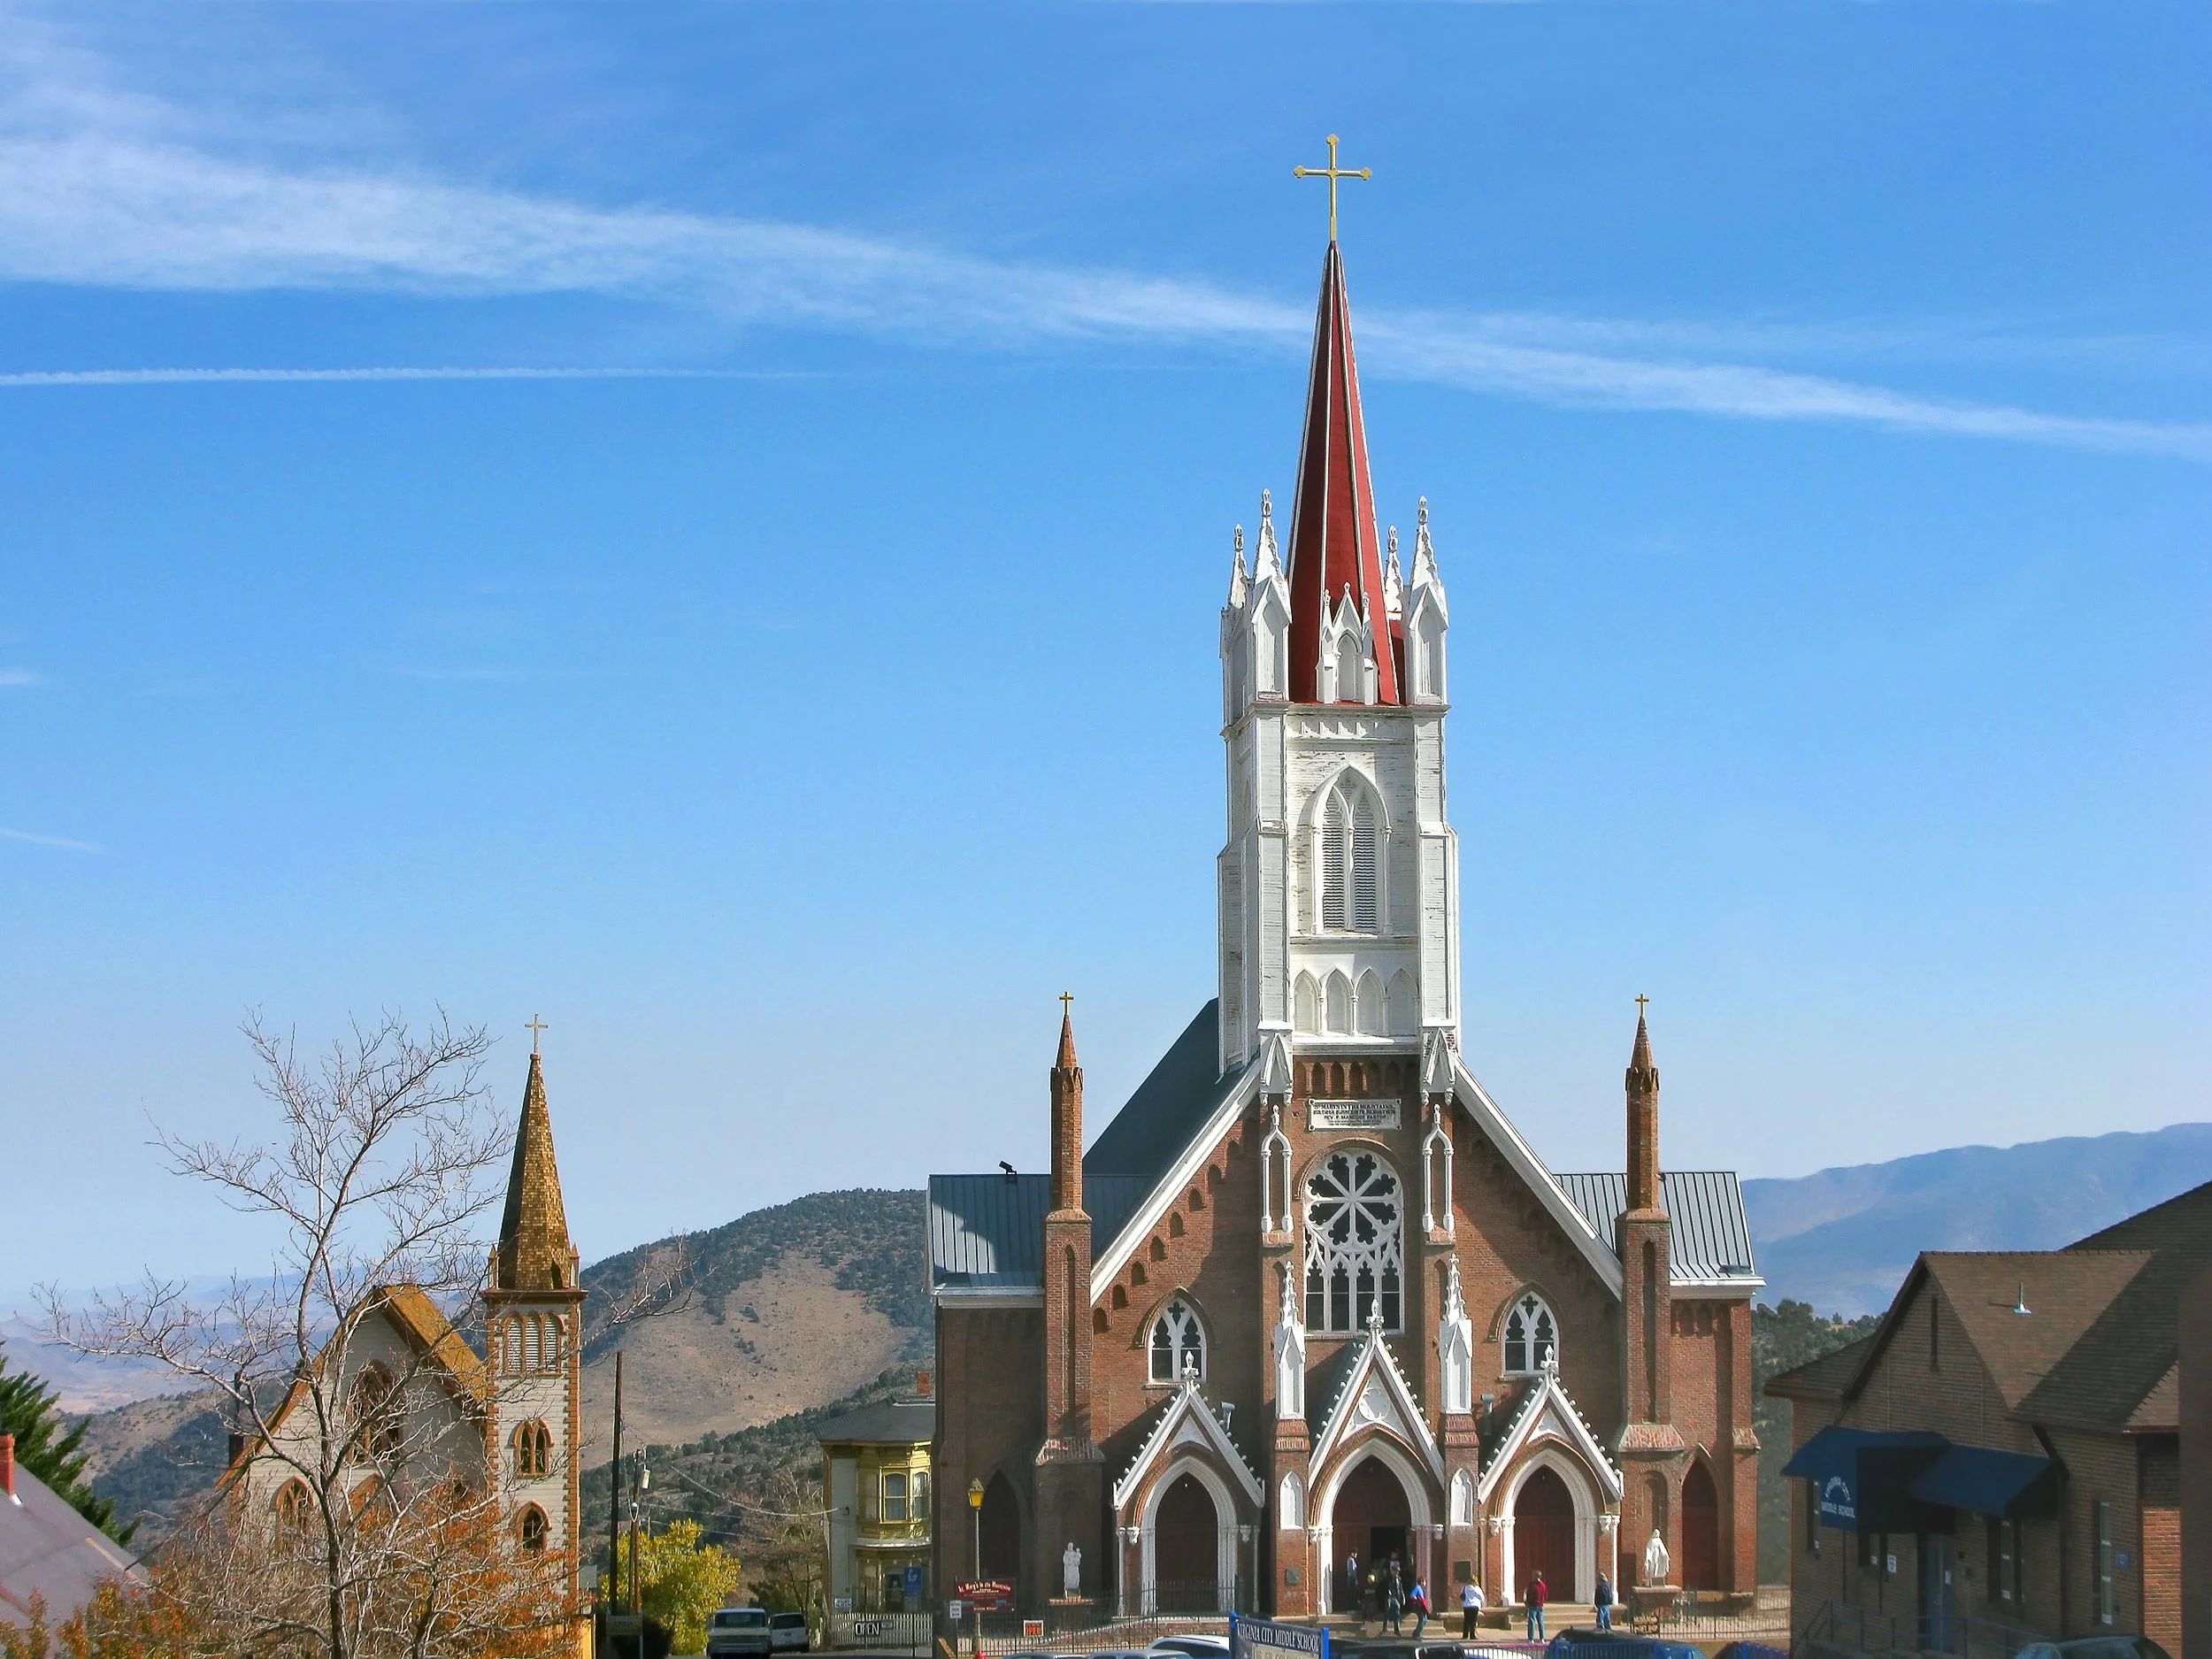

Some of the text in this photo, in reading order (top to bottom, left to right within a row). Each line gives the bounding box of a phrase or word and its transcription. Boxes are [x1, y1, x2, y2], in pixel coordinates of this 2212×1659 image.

[855, 1622, 879, 1635] OPEN
[1237, 1623, 1319, 1651] VIRGINIA CITY MIDDLE SCHOOL
